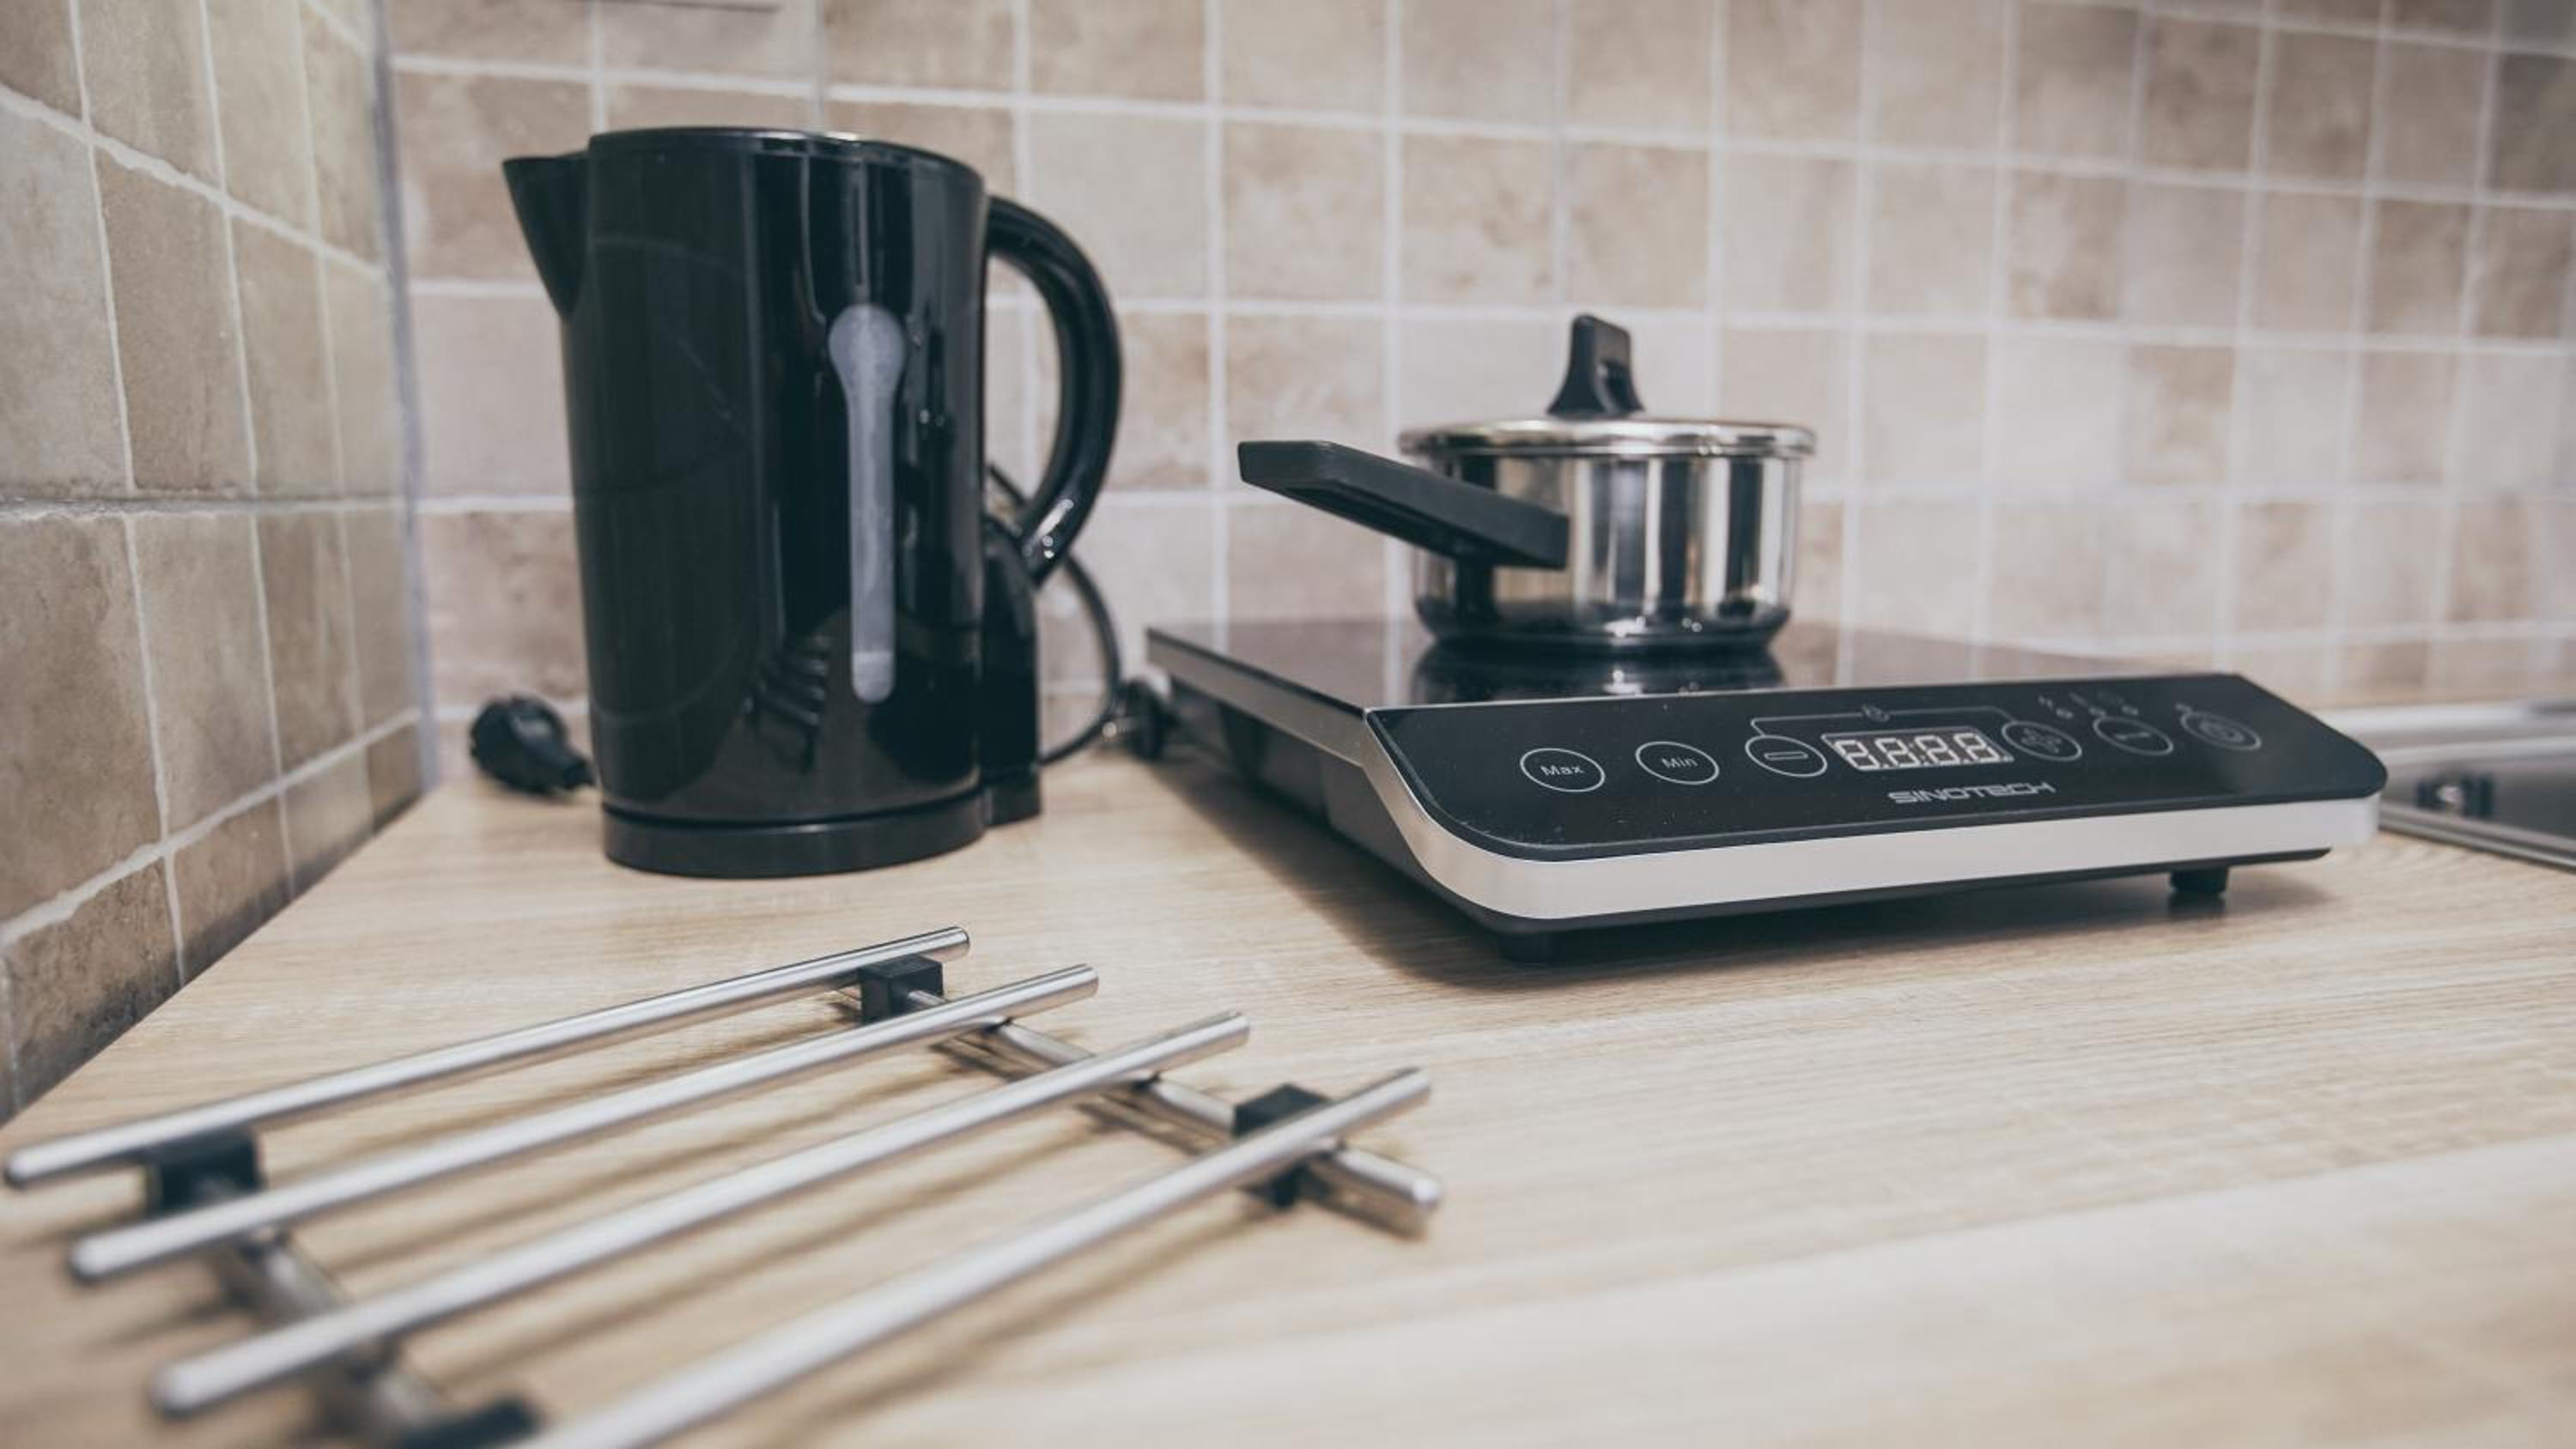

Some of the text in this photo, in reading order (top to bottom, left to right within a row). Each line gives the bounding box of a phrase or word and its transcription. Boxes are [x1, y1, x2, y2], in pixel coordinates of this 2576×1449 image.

[1662, 756, 1698, 768] Min
[1540, 764, 1584, 776] Max
[1887, 782, 2057, 804] SINOTECH
